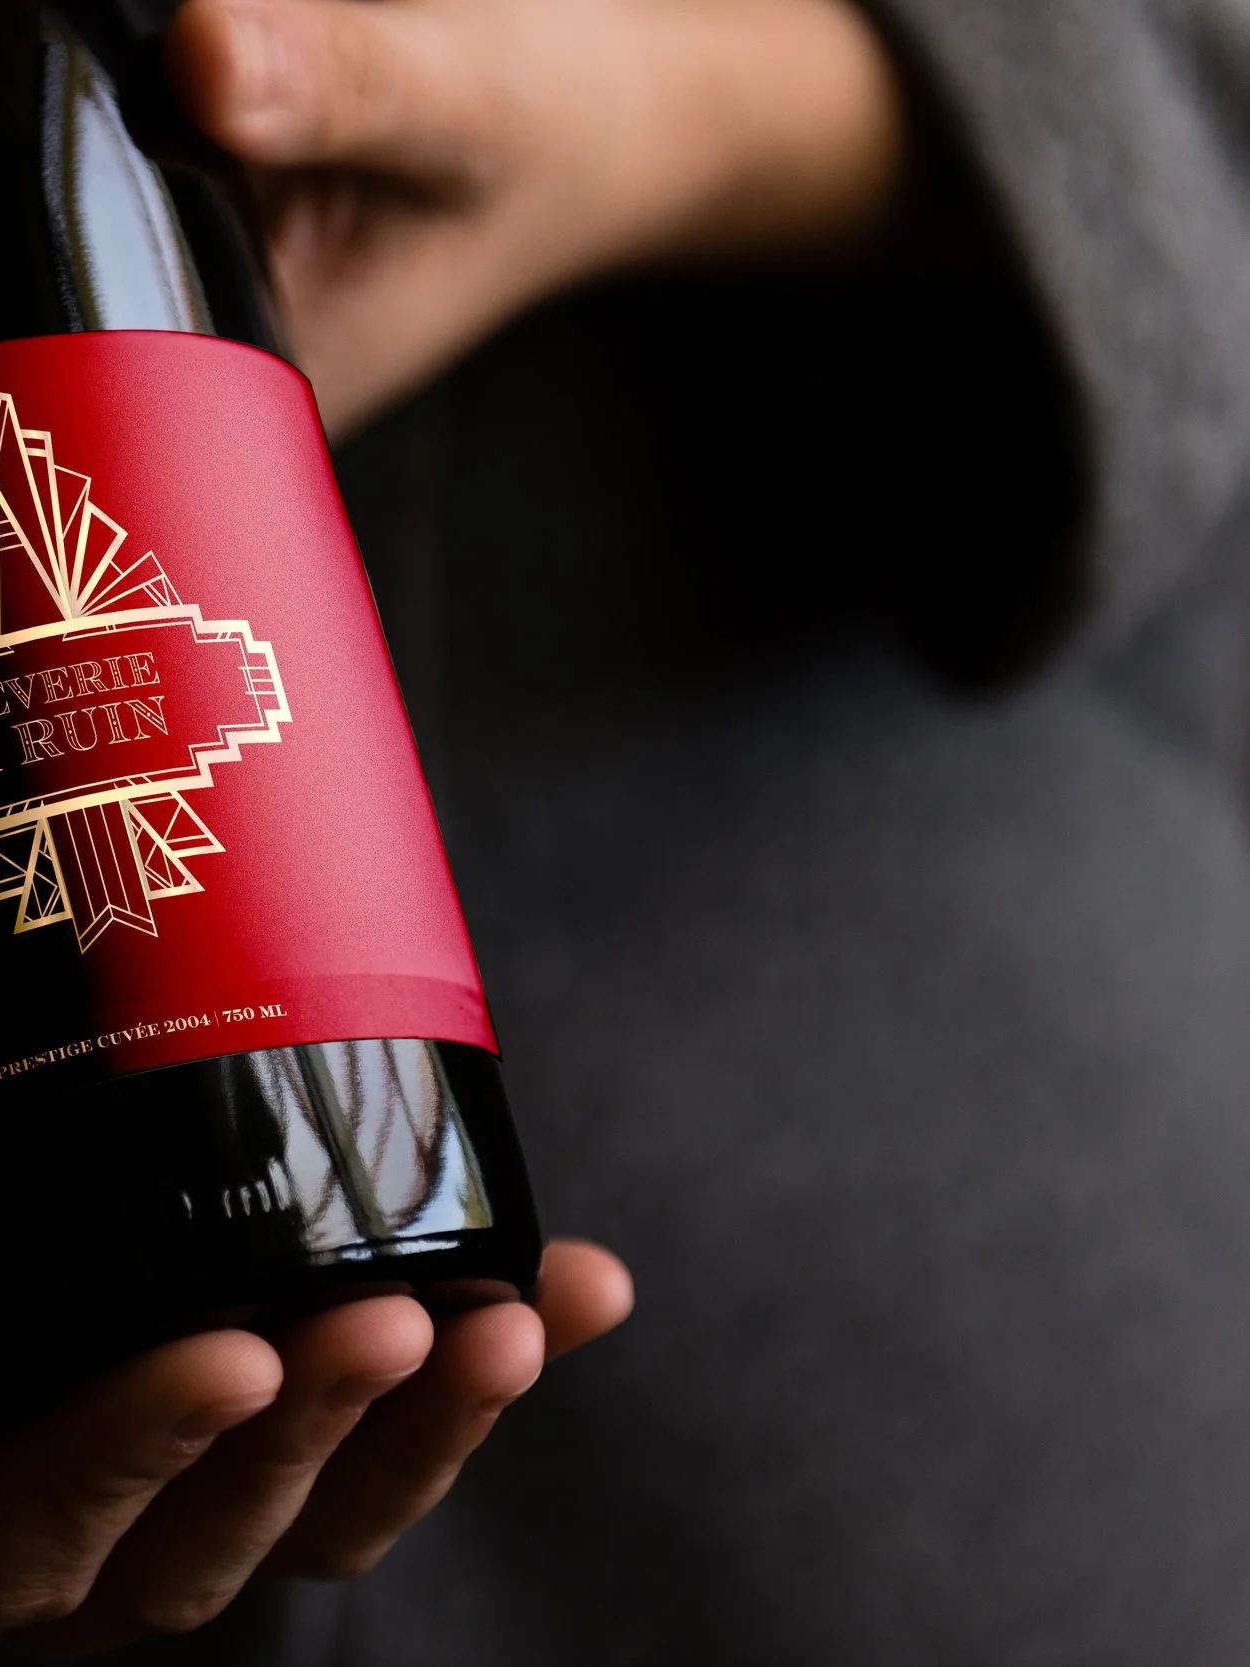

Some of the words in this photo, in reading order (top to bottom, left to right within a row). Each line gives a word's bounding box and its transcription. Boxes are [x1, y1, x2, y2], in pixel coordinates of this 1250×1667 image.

[11, 696, 168, 765] RUIN
[97, 1022, 160, 1048] CUVÉE
[164, 1014, 211, 1033] 2004
[222, 1007, 254, 1023] 750
[259, 1004, 288, 1019] ML
